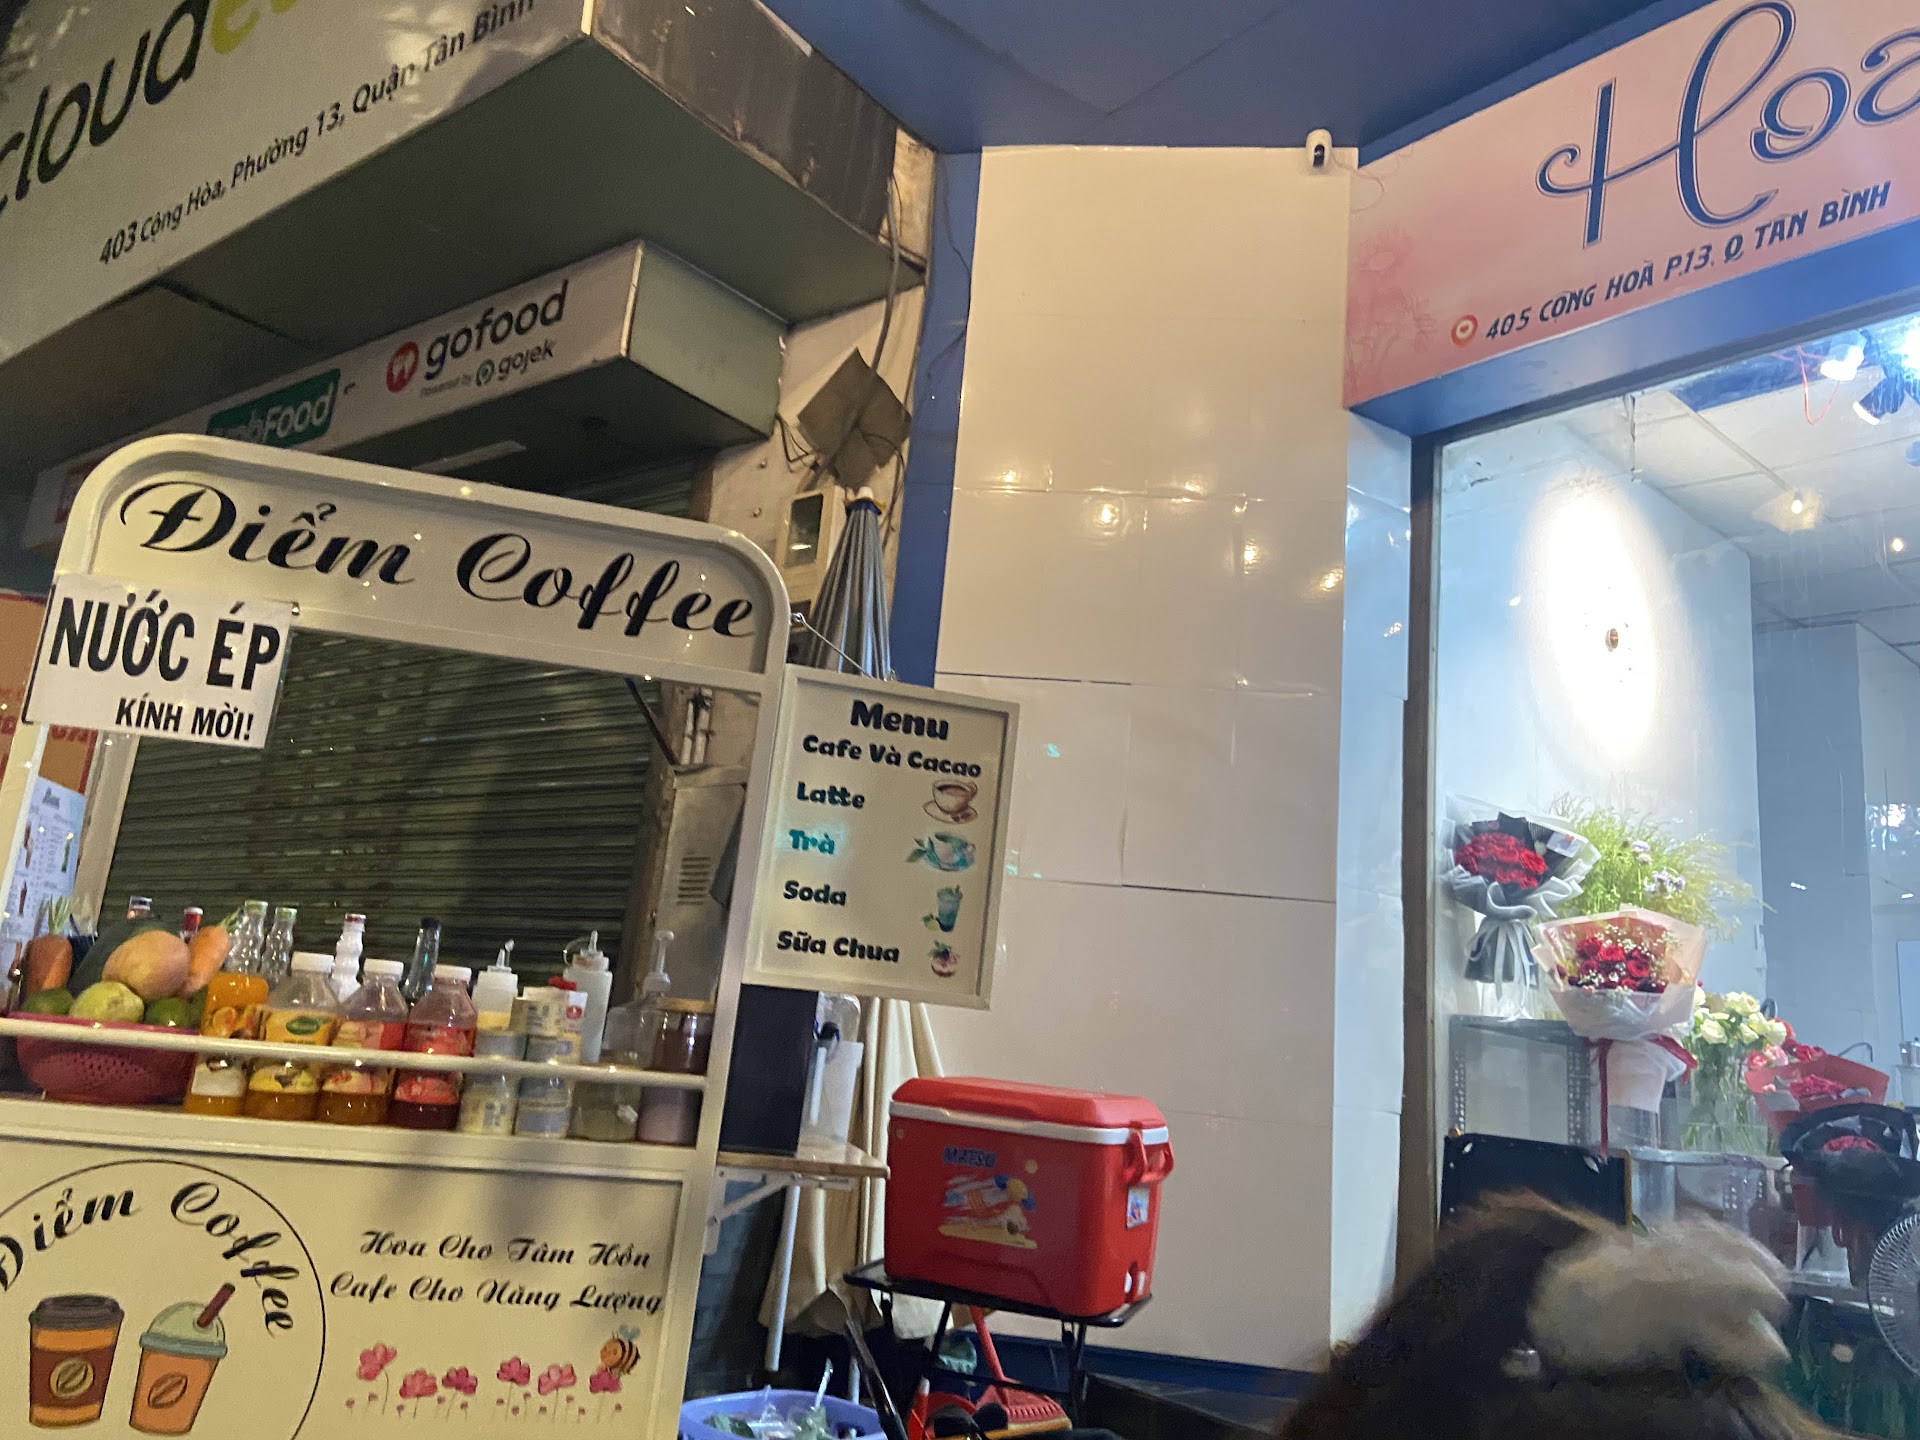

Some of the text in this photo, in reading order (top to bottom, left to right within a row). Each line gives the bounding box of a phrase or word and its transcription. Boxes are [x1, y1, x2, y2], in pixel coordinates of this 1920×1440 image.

[100, 221, 138, 265] 403
[230, 126, 309, 189] Phường
[316, 102, 346, 136] 13,
[424, 31, 466, 72] Tân
[1486, 306, 1532, 340] 405
[1604, 259, 1654, 301] HOÀ
[1818, 180, 1892, 229] BÌNH
[424, 279, 569, 381] gofood
[498, 339, 556, 381] gojek
[119, 480, 756, 638] Điểm Coffee
[49, 588, 281, 691] NƯỚC ÉP
[114, 693, 184, 733] KÍNH
[190, 702, 255, 742] MỜI!
[849, 699, 950, 741] Menu
[801, 734, 983, 779] Cafe Và Cacao
[796, 781, 866, 809] Latte
[788, 829, 836, 856] Trà
[782, 880, 848, 907] Soda
[776, 930, 901, 964] Sữa Chua
[170, 1181, 300, 1339] Coffee
[359, 1229, 429, 1258] Hoa
[438, 1234, 494, 1261] Cho
[329, 1270, 399, 1305] Cafe
[408, 1274, 464, 1303] Cho
